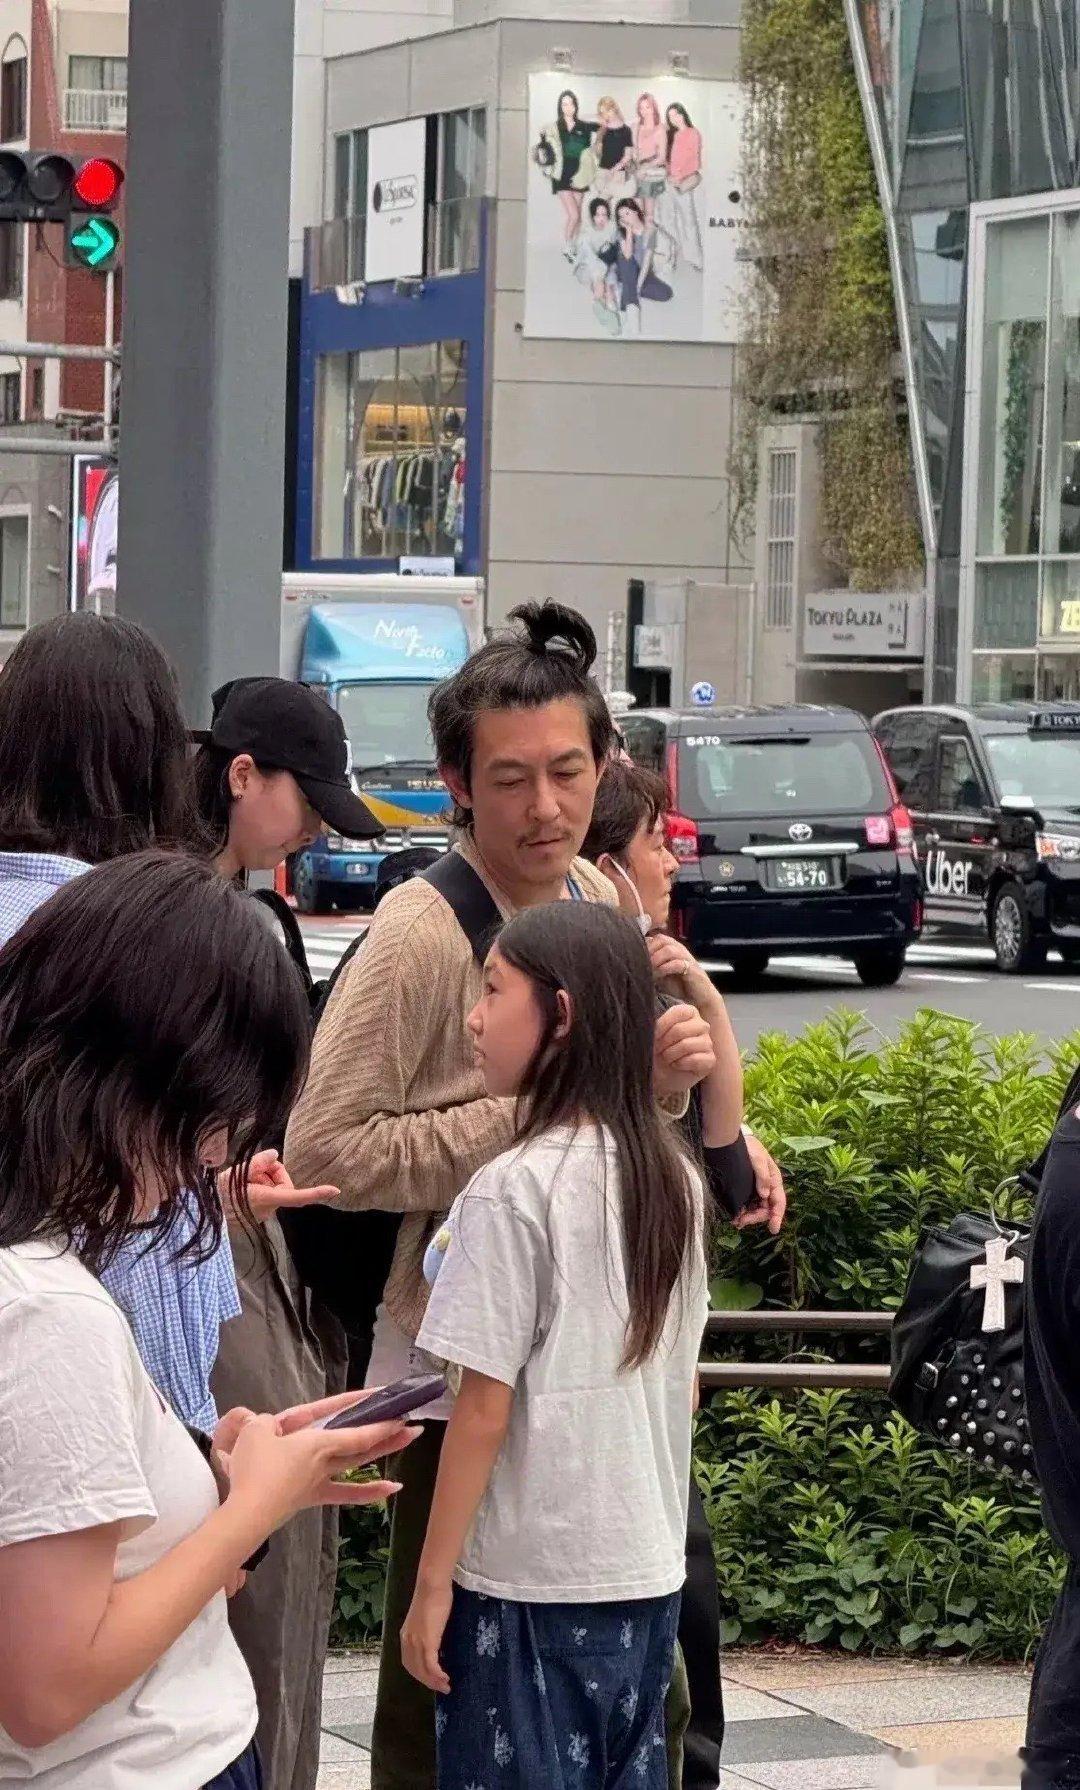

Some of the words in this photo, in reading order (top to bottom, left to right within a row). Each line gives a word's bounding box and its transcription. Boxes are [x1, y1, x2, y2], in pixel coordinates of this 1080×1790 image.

[808, 608, 843, 626] TOKYU
[846, 607, 883, 626] PLAZA
[787, 870, 827, 886] 54-70
[926, 851, 973, 895] Uber
